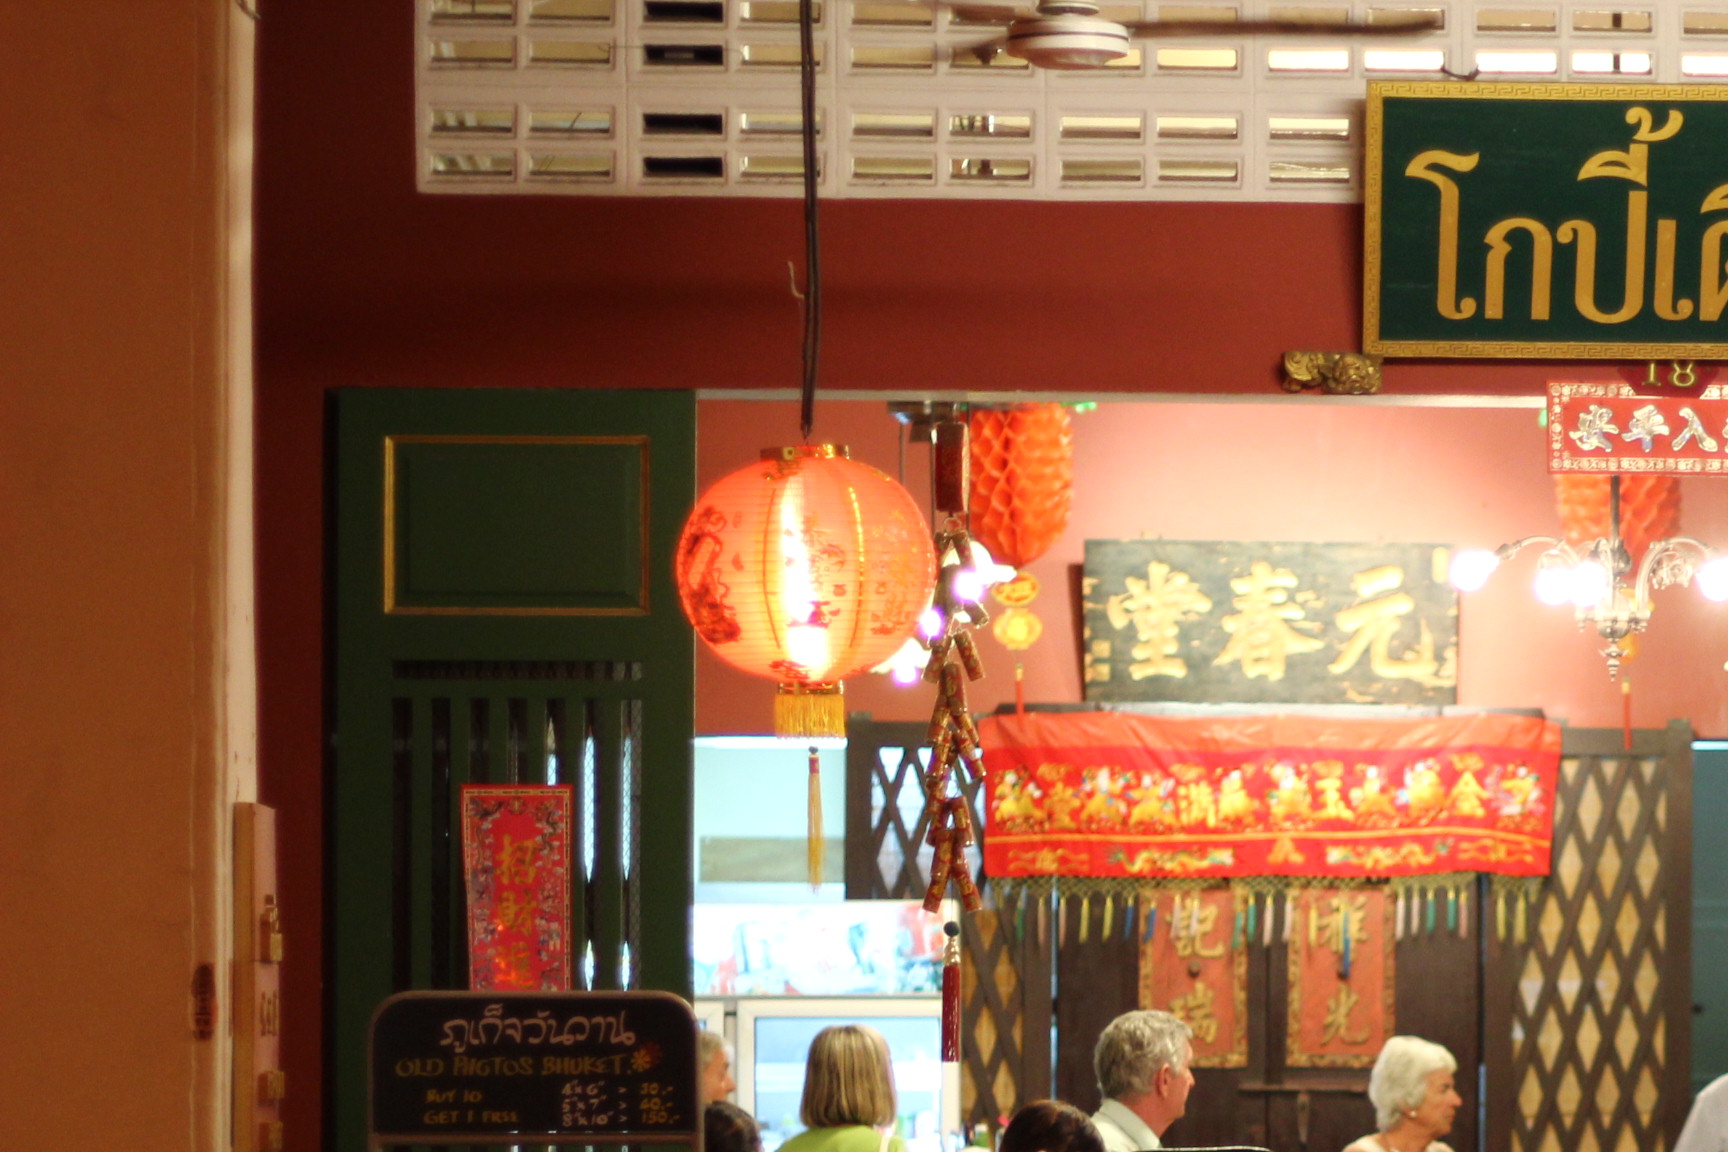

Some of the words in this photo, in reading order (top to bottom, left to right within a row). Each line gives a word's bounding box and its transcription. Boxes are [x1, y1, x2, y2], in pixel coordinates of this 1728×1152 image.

[395, 1056, 445, 1078] OLD
[425, 1089, 457, 1104] BUY
[463, 1089, 483, 1103] 10
[423, 1110, 460, 1124] GET
